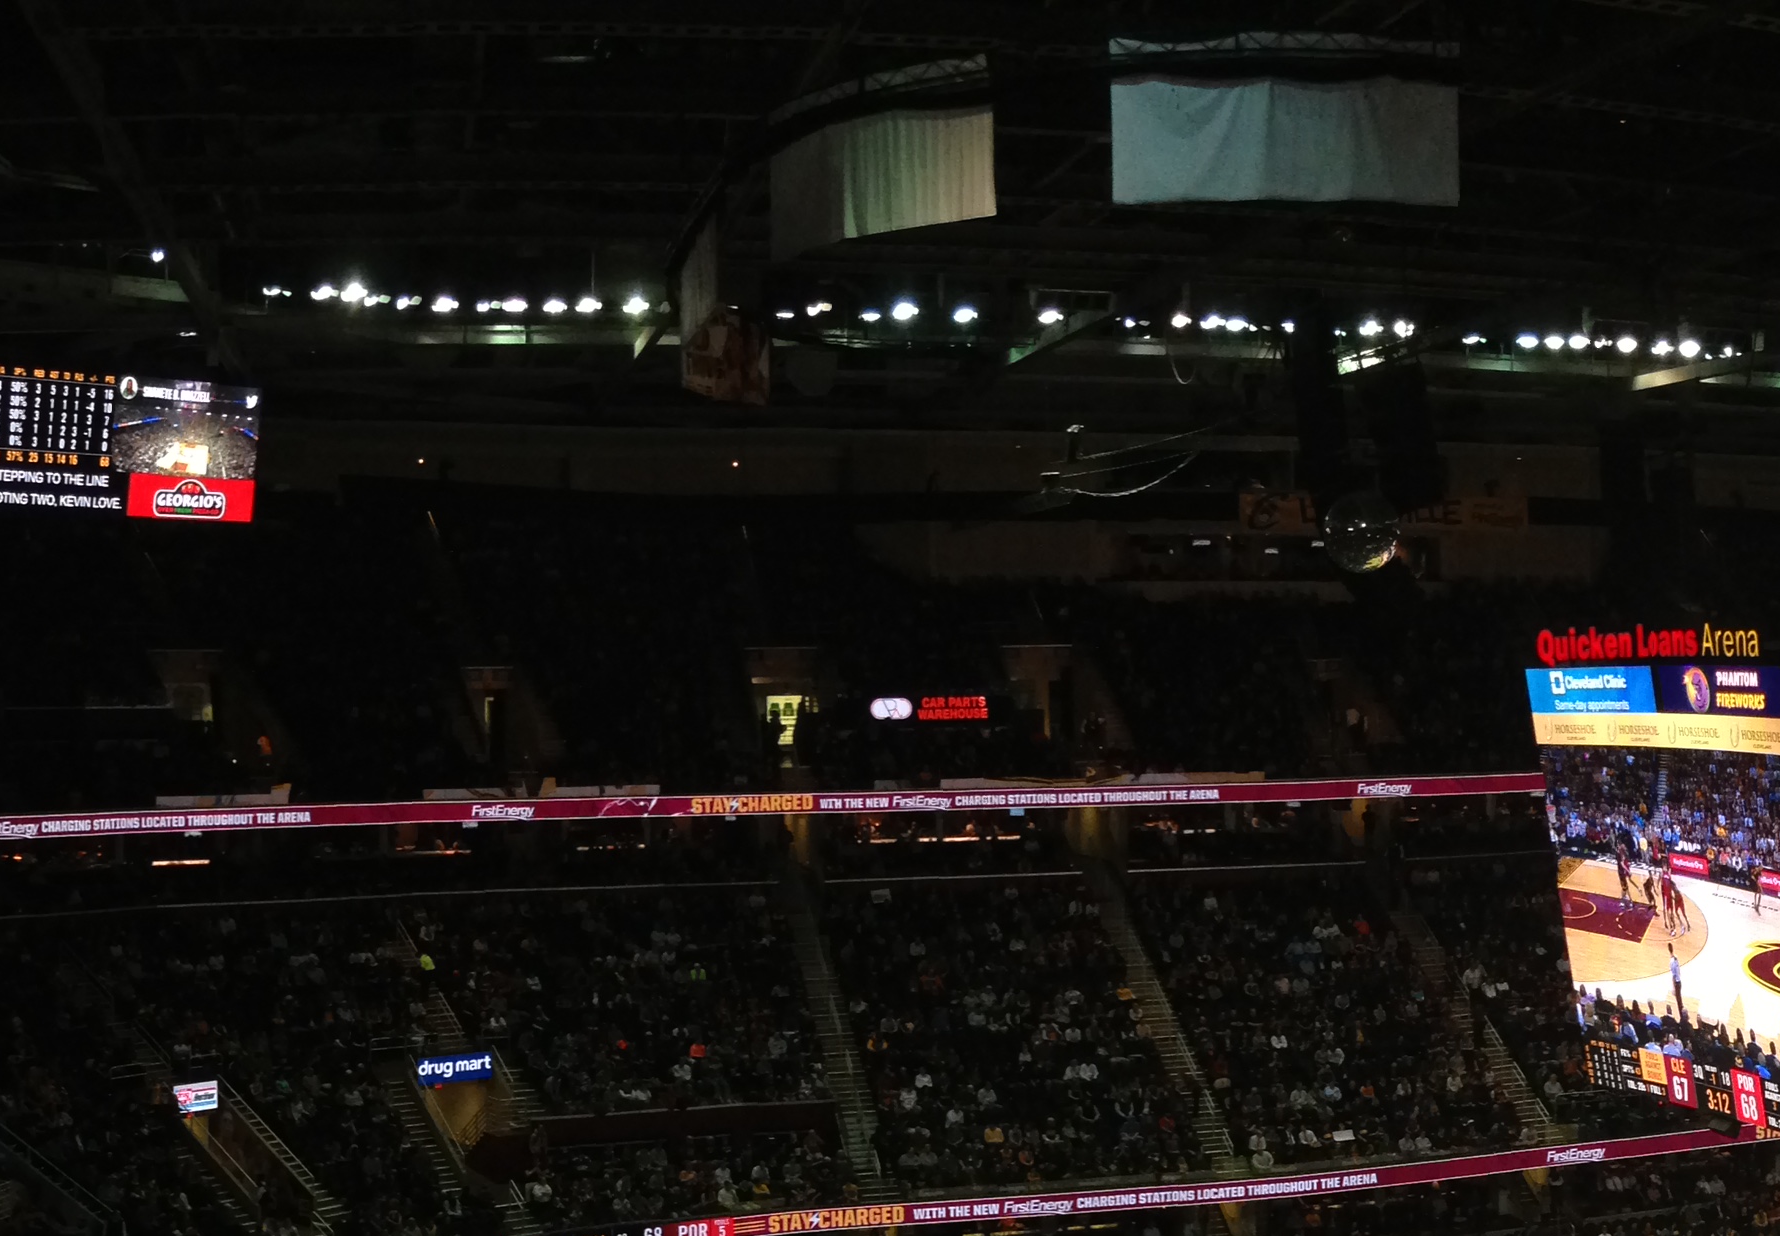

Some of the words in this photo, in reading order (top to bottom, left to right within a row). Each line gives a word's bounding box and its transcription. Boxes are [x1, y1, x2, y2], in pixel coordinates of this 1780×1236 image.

[46, 471, 62, 485] TO
[63, 472, 86, 486] THE
[86, 473, 109, 487] LINE
[31, 493, 58, 507] TWO,
[60, 495, 91, 509] KEVIN
[92, 497, 122, 510] LOVE.
[157, 494, 223, 509] GEORGIO'S
[1536, 625, 1633, 668] Quicken
[1635, 622, 1699, 659] Loans
[1701, 622, 1760, 658] Arena
[1565, 674, 1602, 690] Cleveland
[1603, 673, 1627, 690] Clinic
[1715, 671, 1759, 687] PHANTOM
[921, 696, 945, 709] CAR
[947, 695, 987, 708] PARTS
[1554, 699, 1587, 712] Same-day
[1588, 699, 1630, 712] appointments
[1716, 693, 1766, 710] FIREWORKS
[917, 707, 989, 721] WAREHOUSE
[1554, 723, 1597, 735] HORSESHOE
[1618, 724, 1660, 736] HORSESHOE
[1677, 726, 1720, 738] HORSESHOE
[471, 803, 535, 819] FirstEnergy
[41, 819, 92, 834] CHARGING
[92, 817, 141, 831] STATIONS
[141, 815, 186, 829] LOCATED
[187, 812, 254, 828] THROUGHOUT
[255, 812, 276, 825] THE
[277, 811, 312, 824] ARENA
[418, 1059, 453, 1079] drug
[455, 1054, 492, 1073] mart
[1670, 1058, 1687, 1075] CLE
[1672, 1077, 1689, 1102] 67
[1737, 1073, 1755, 1092] POR
[1706, 1089, 1732, 1115] 3:12
[1741, 1095, 1759, 1121] 68
[1546, 1146, 1606, 1164] FirstEnergy
[768, 1212, 813, 1234] STAY
[818, 1206, 905, 1229] CHARGED
